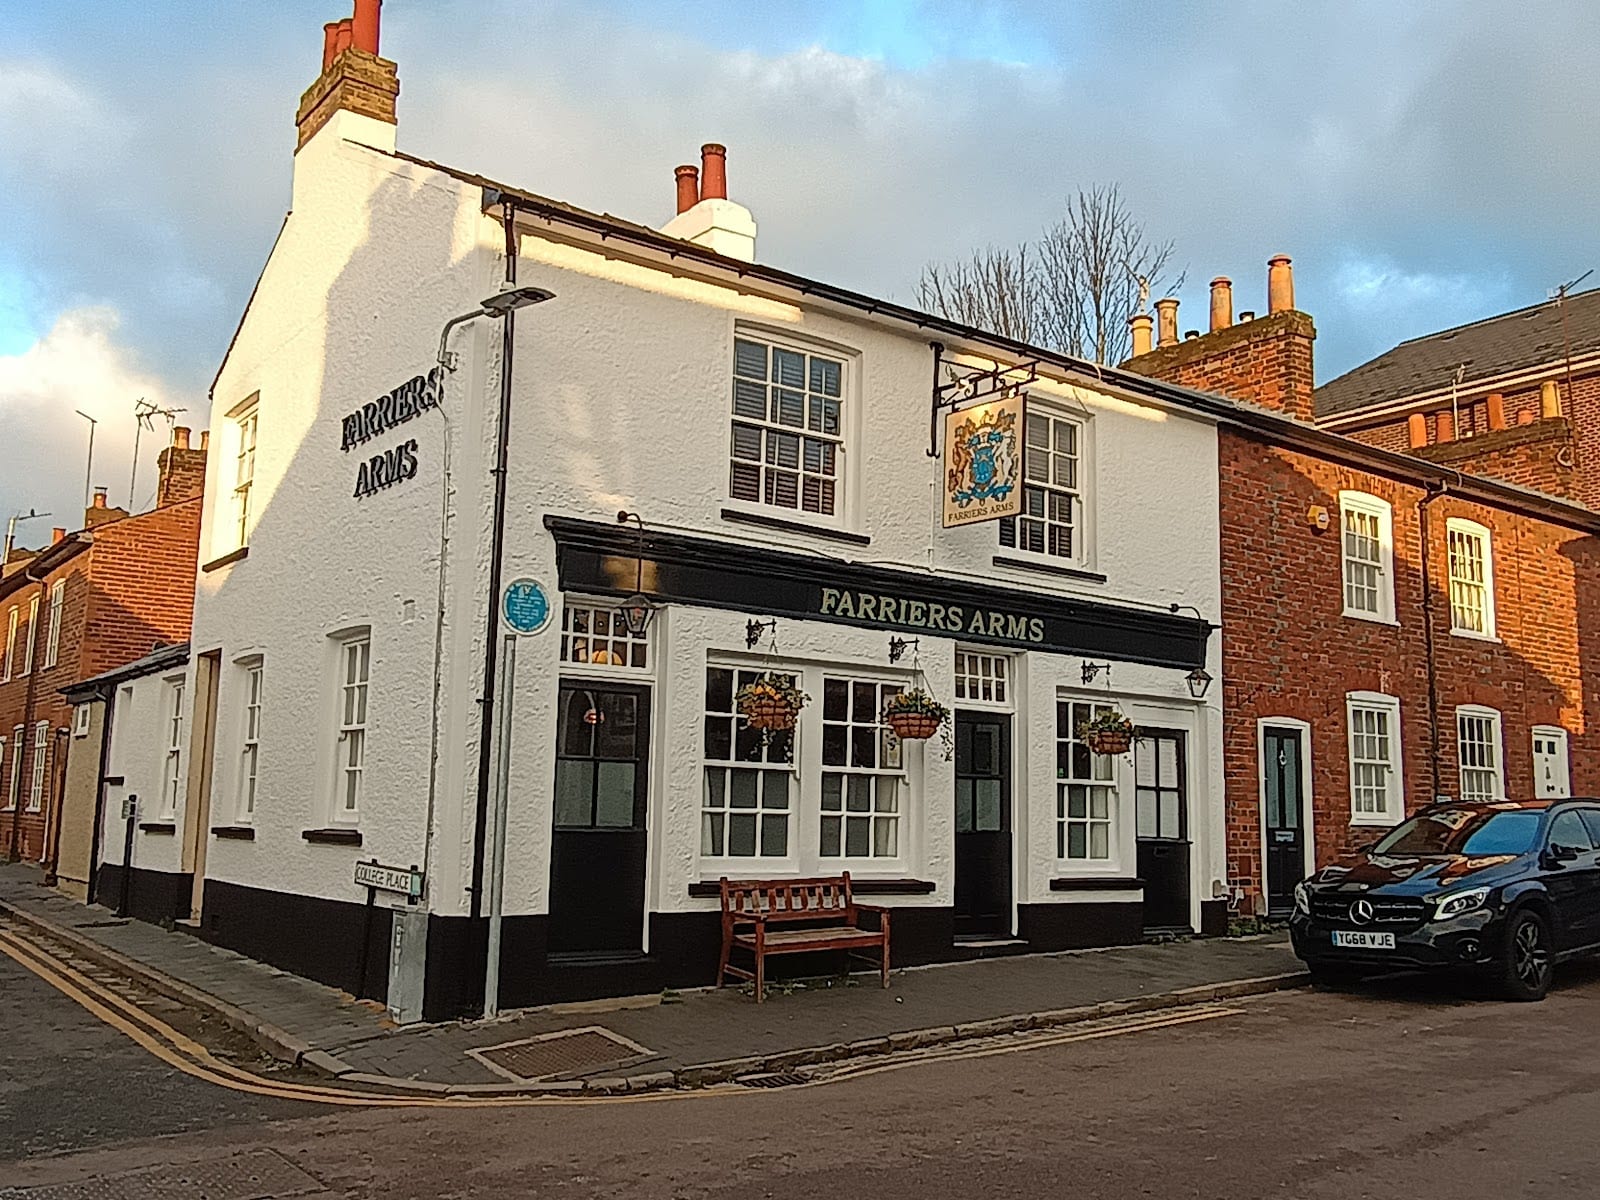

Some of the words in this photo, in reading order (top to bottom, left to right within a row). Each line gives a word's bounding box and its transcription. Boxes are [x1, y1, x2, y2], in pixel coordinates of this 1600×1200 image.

[340, 366, 444, 452] FARRIERS
[353, 439, 418, 500] ARMS
[948, 507, 988, 522] FARRIERS
[990, 501, 1014, 515] ARMS
[819, 587, 963, 632] FARRIERS
[967, 610, 1044, 642] ARMS
[355, 866, 385, 885] COLLEGE
[386, 872, 409, 890] PLACE
[1339, 933, 1366, 945] YG68
[1369, 934, 1393, 947] VJE
